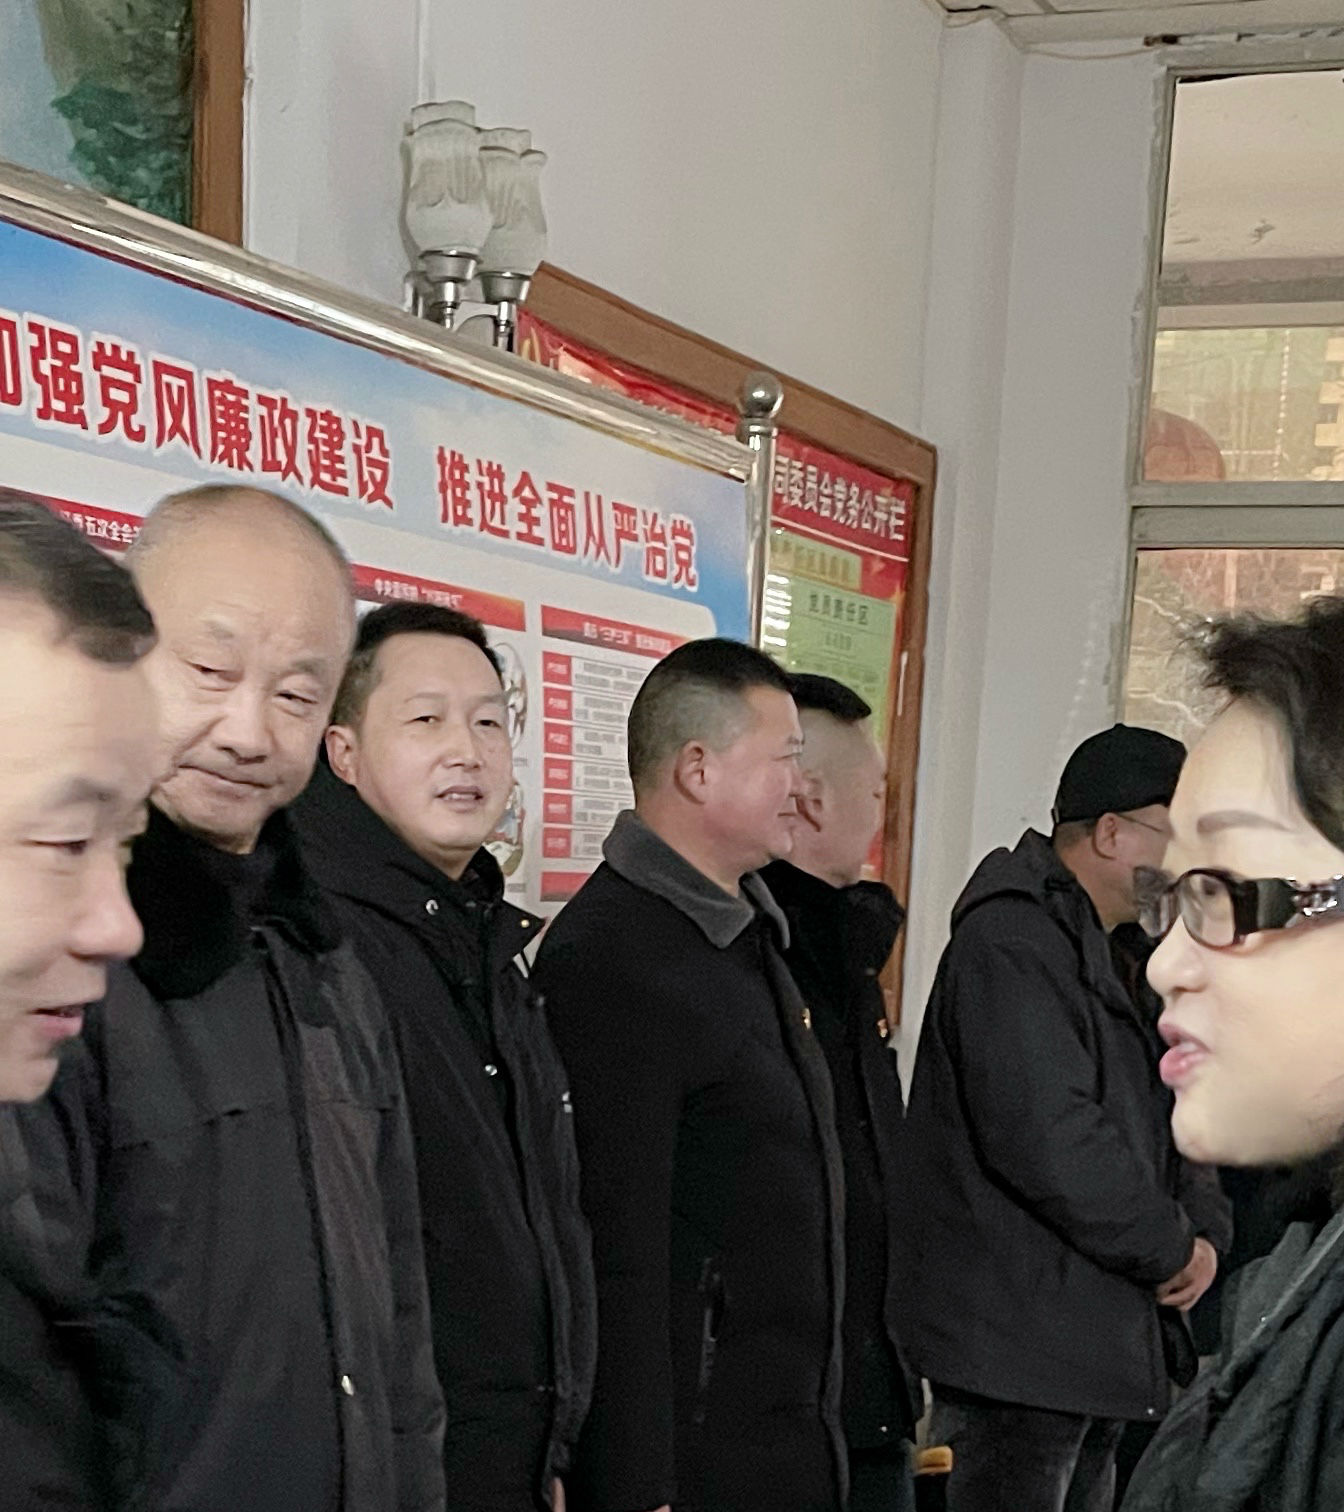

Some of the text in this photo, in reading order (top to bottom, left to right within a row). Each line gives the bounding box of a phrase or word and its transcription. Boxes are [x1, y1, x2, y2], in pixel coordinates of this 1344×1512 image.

[437, 446, 697, 588] 推进全面从严治党
